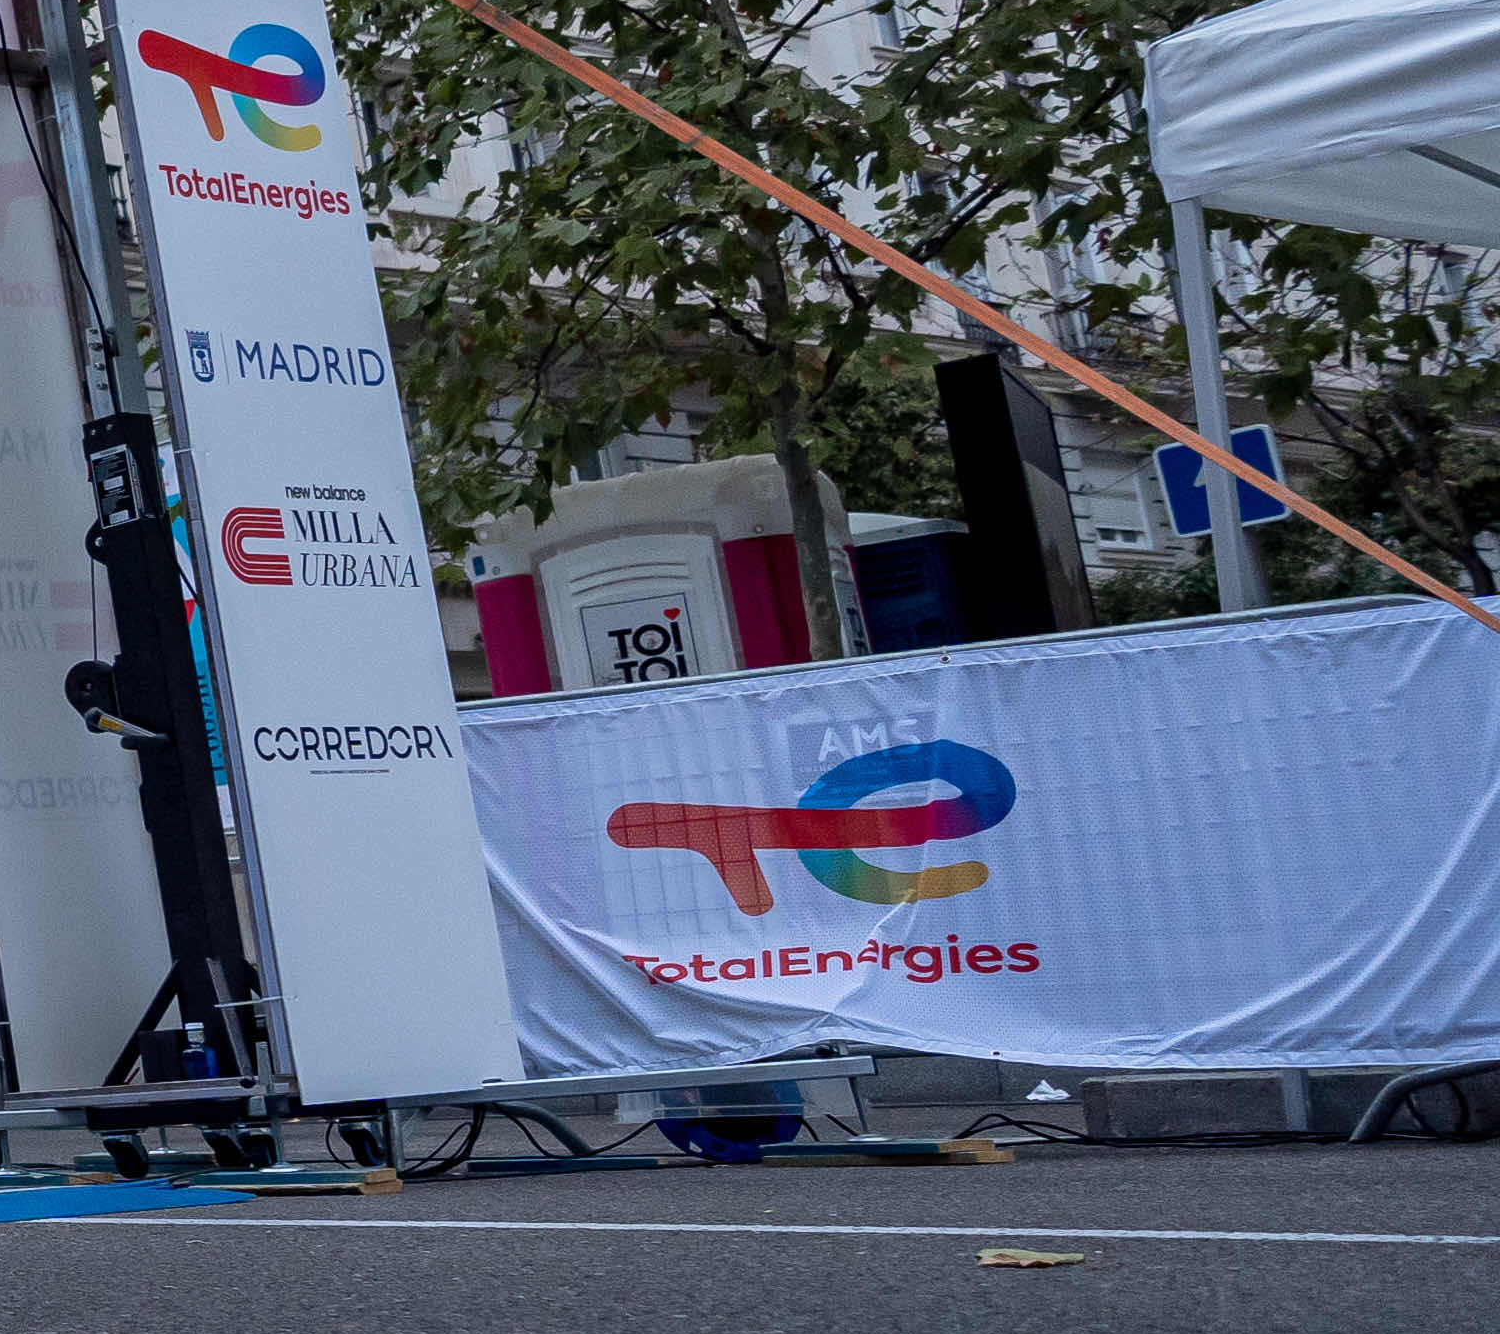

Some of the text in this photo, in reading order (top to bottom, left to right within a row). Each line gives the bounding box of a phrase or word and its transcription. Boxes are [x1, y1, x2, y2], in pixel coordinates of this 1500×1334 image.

[158, 164, 350, 220] TotalEnergies
[235, 339, 385, 387] MADRID
[285, 485, 366, 504] new balance
[292, 509, 398, 545] MILLA
[300, 553, 421, 588] URBANA
